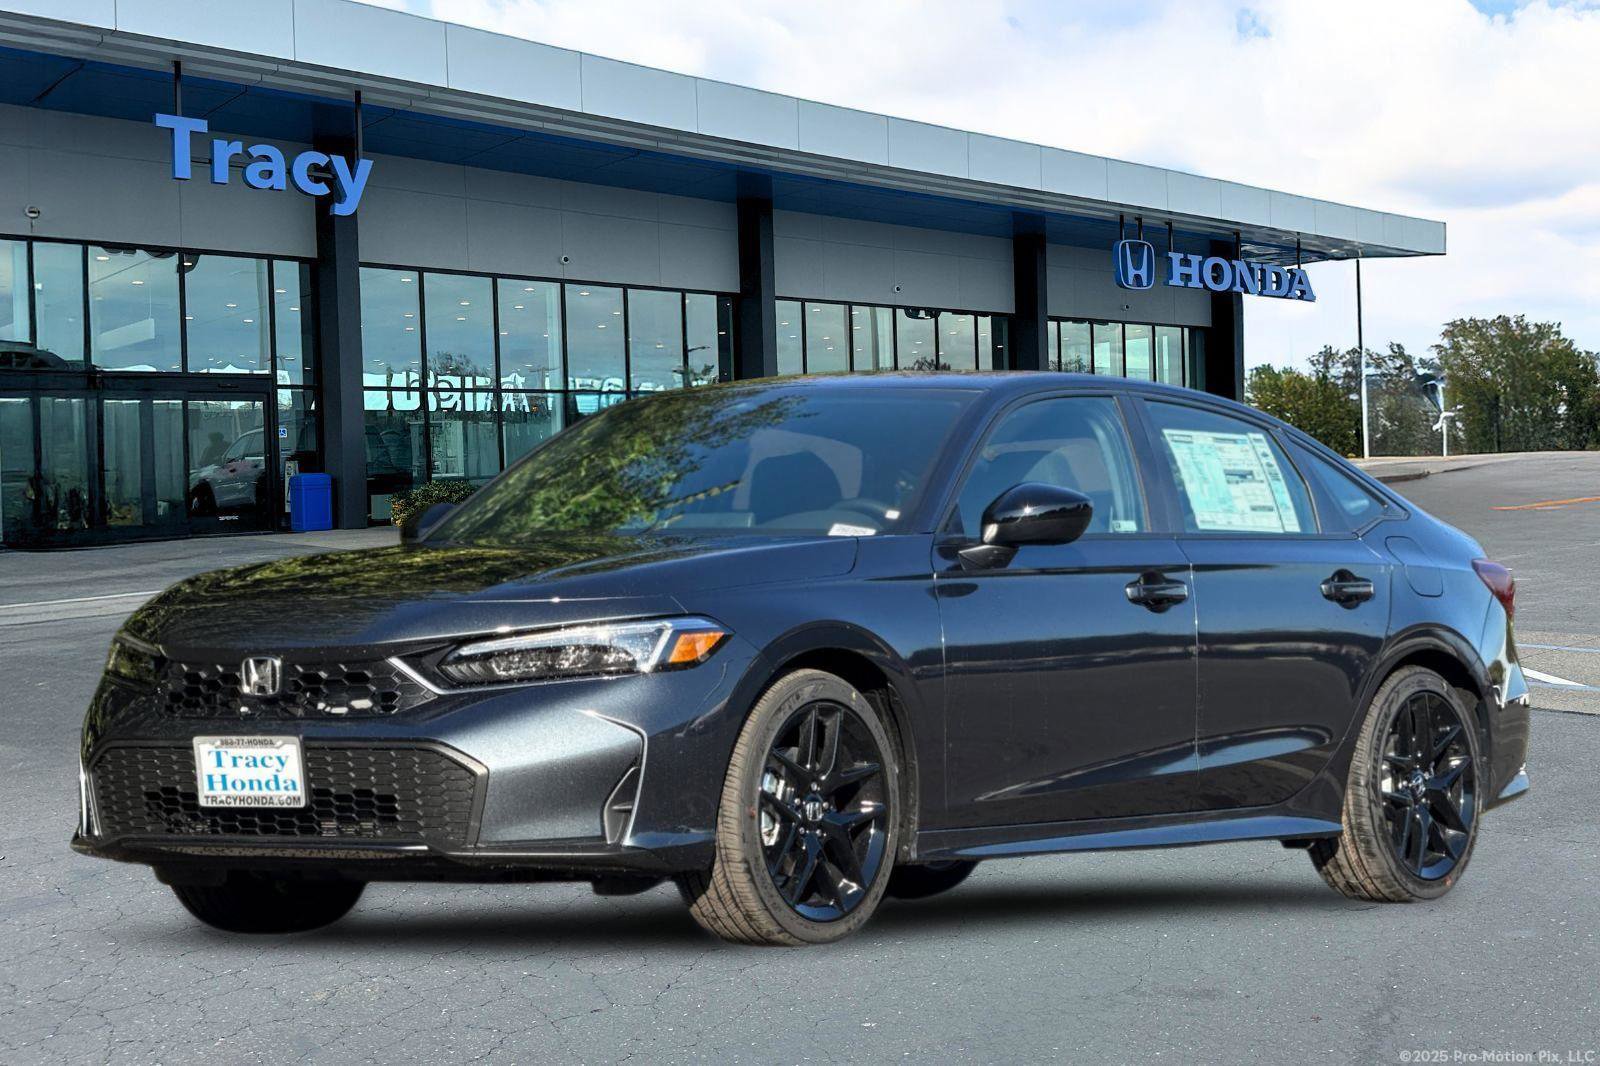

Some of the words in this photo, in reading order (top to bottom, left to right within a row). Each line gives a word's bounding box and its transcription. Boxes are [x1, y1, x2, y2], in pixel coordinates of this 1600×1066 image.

[154, 113, 374, 216] Tracy
[1166, 251, 1316, 301] HONDA
[208, 750, 289, 772] Tracy
[206, 774, 298, 791] Honda
[204, 796, 301, 806] TRACYHONDA.COM
